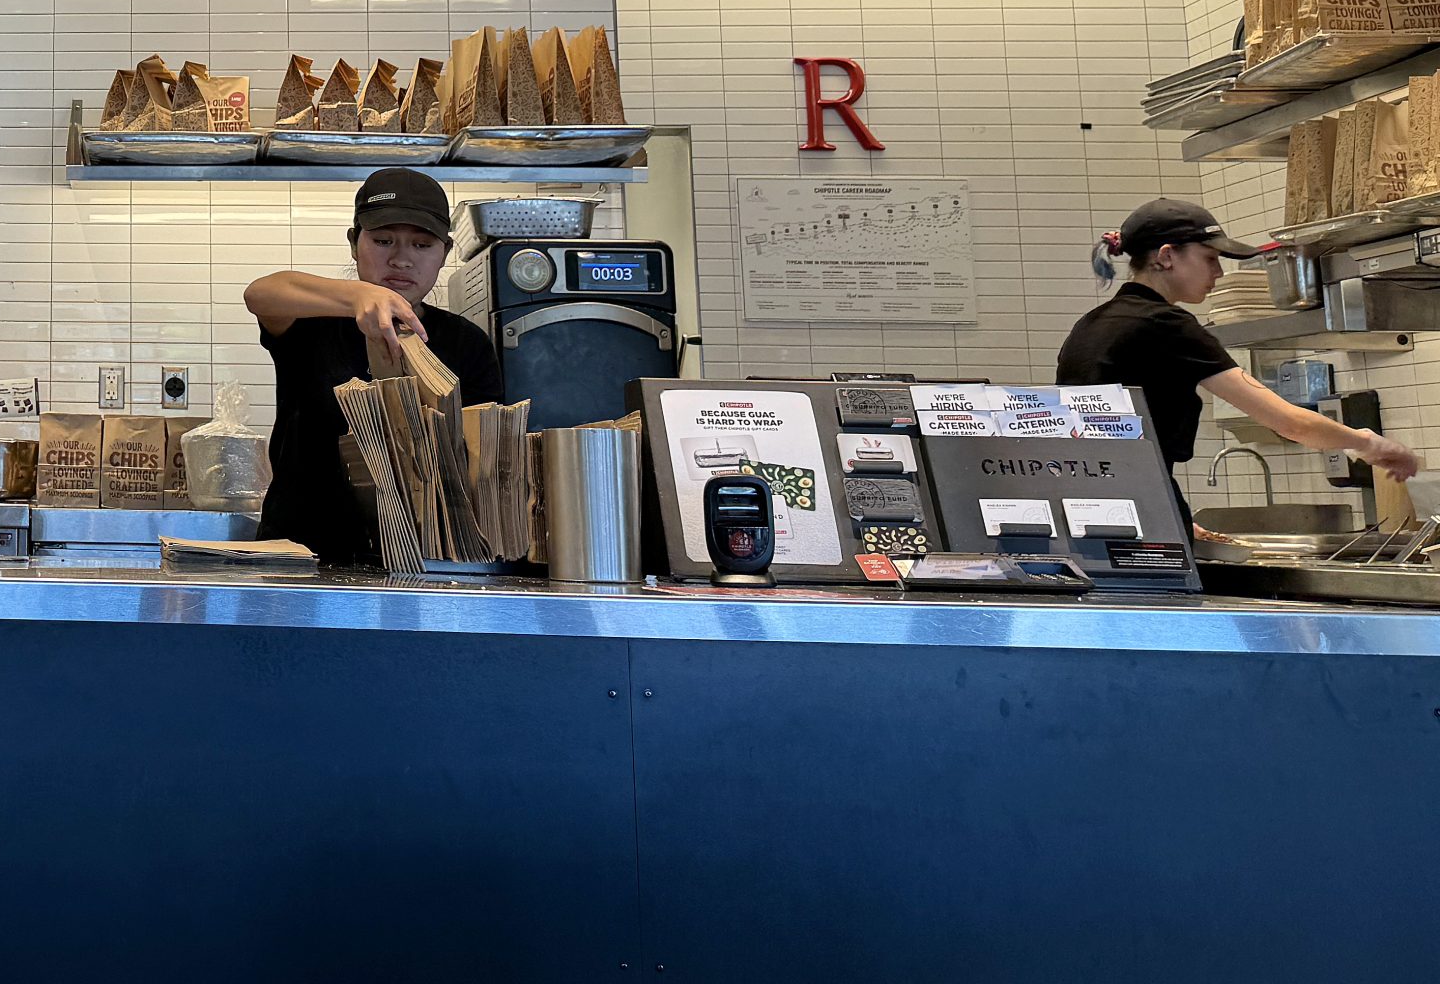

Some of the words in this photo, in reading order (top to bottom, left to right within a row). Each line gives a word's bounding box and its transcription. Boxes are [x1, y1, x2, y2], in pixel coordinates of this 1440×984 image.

[1335, 8, 1382, 19] LOVINGLY
[1329, 19, 1377, 31] CRAFTED
[794, 58, 885, 151] R
[592, 268, 632, 280] 00:03
[1007, 394, 1038, 402] WE'RE
[931, 402, 973, 410] HIRING
[1068, 403, 1111, 412] HIRING
[929, 422, 985, 430] CATERING
[1009, 418, 1065, 430] CATERING
[63, 441, 79, 449] OUR
[127, 442, 142, 451] OUR
[46, 450, 96, 465] CHIPS
[109, 452, 159, 468] CHIPS
[53, 468, 95, 479] LOVINGLY
[982, 458, 1115, 478] CHIPOTLE
[116, 470, 159, 481] LOVINGLY
[47, 479, 88, 489] CRAFTED
[109, 481, 151, 492] CRAFTED
